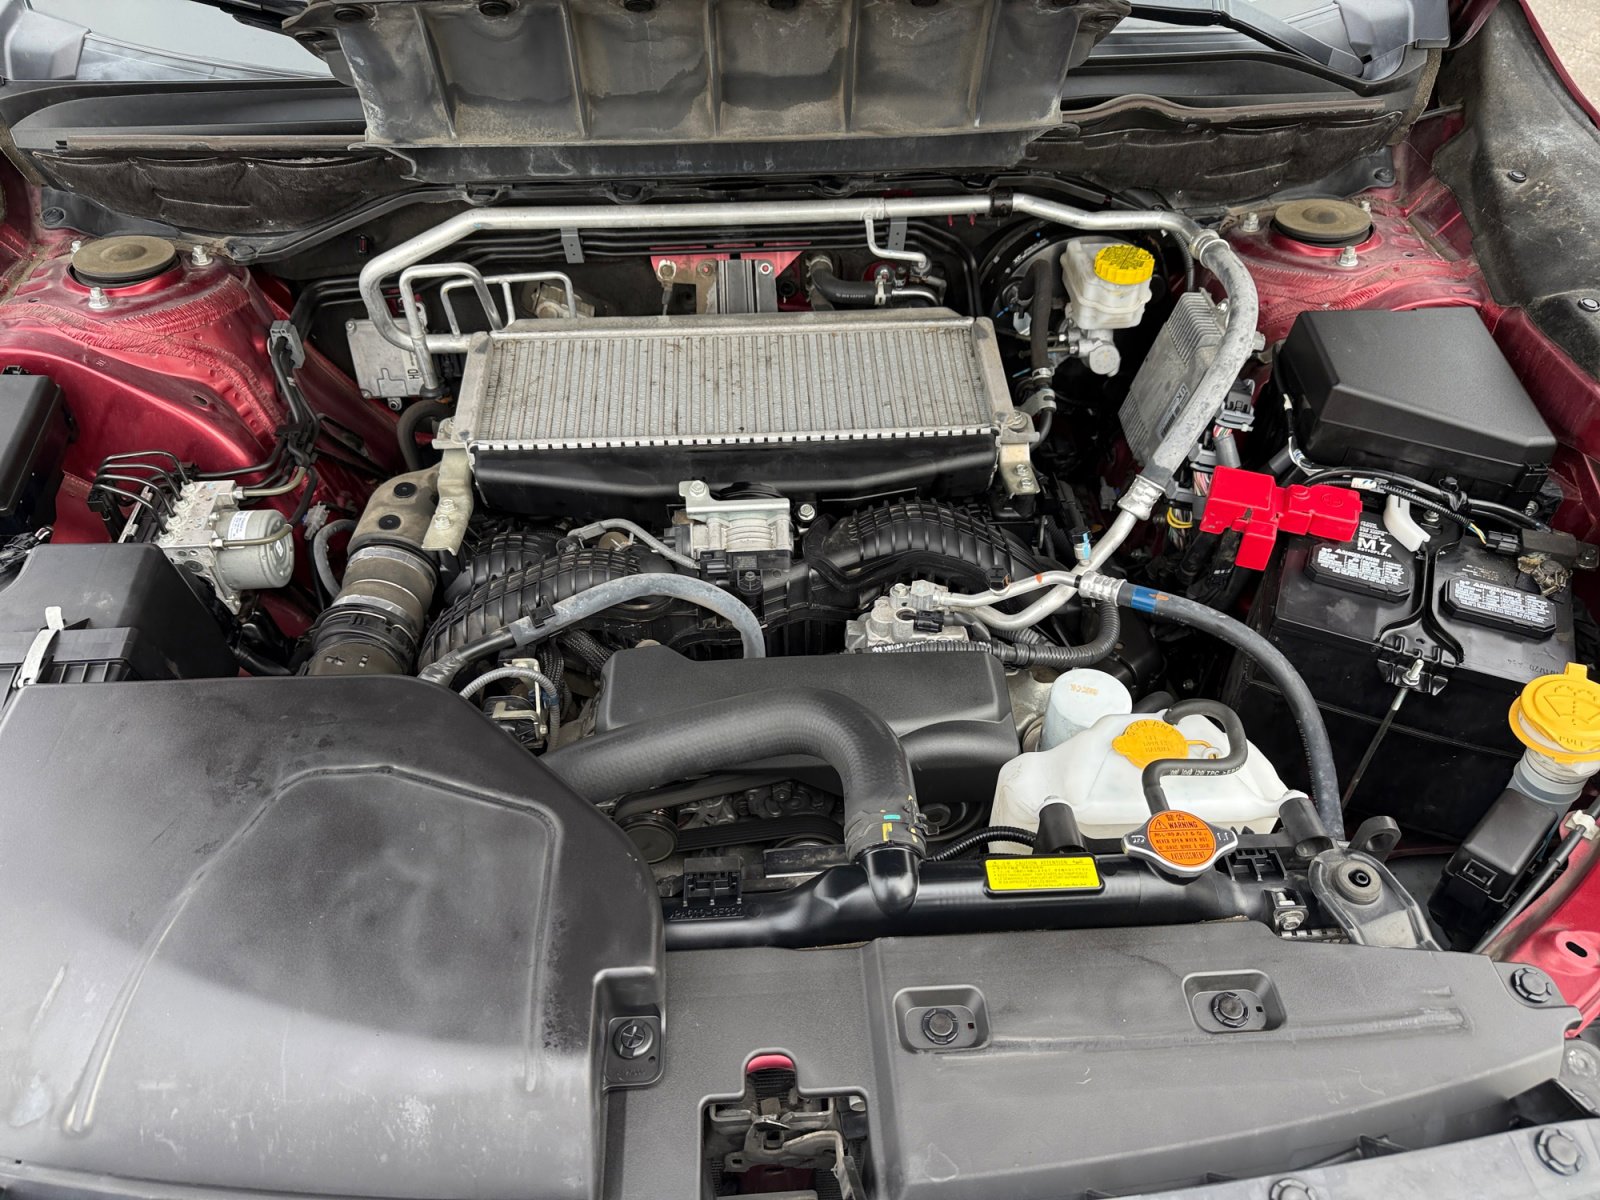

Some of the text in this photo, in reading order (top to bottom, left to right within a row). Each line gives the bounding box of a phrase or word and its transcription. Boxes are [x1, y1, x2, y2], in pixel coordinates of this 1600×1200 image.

[1357, 536, 1393, 554] M7
[1168, 820, 1198, 829] WARNING
[1170, 851, 1206, 860] AVERTISSEMENT
